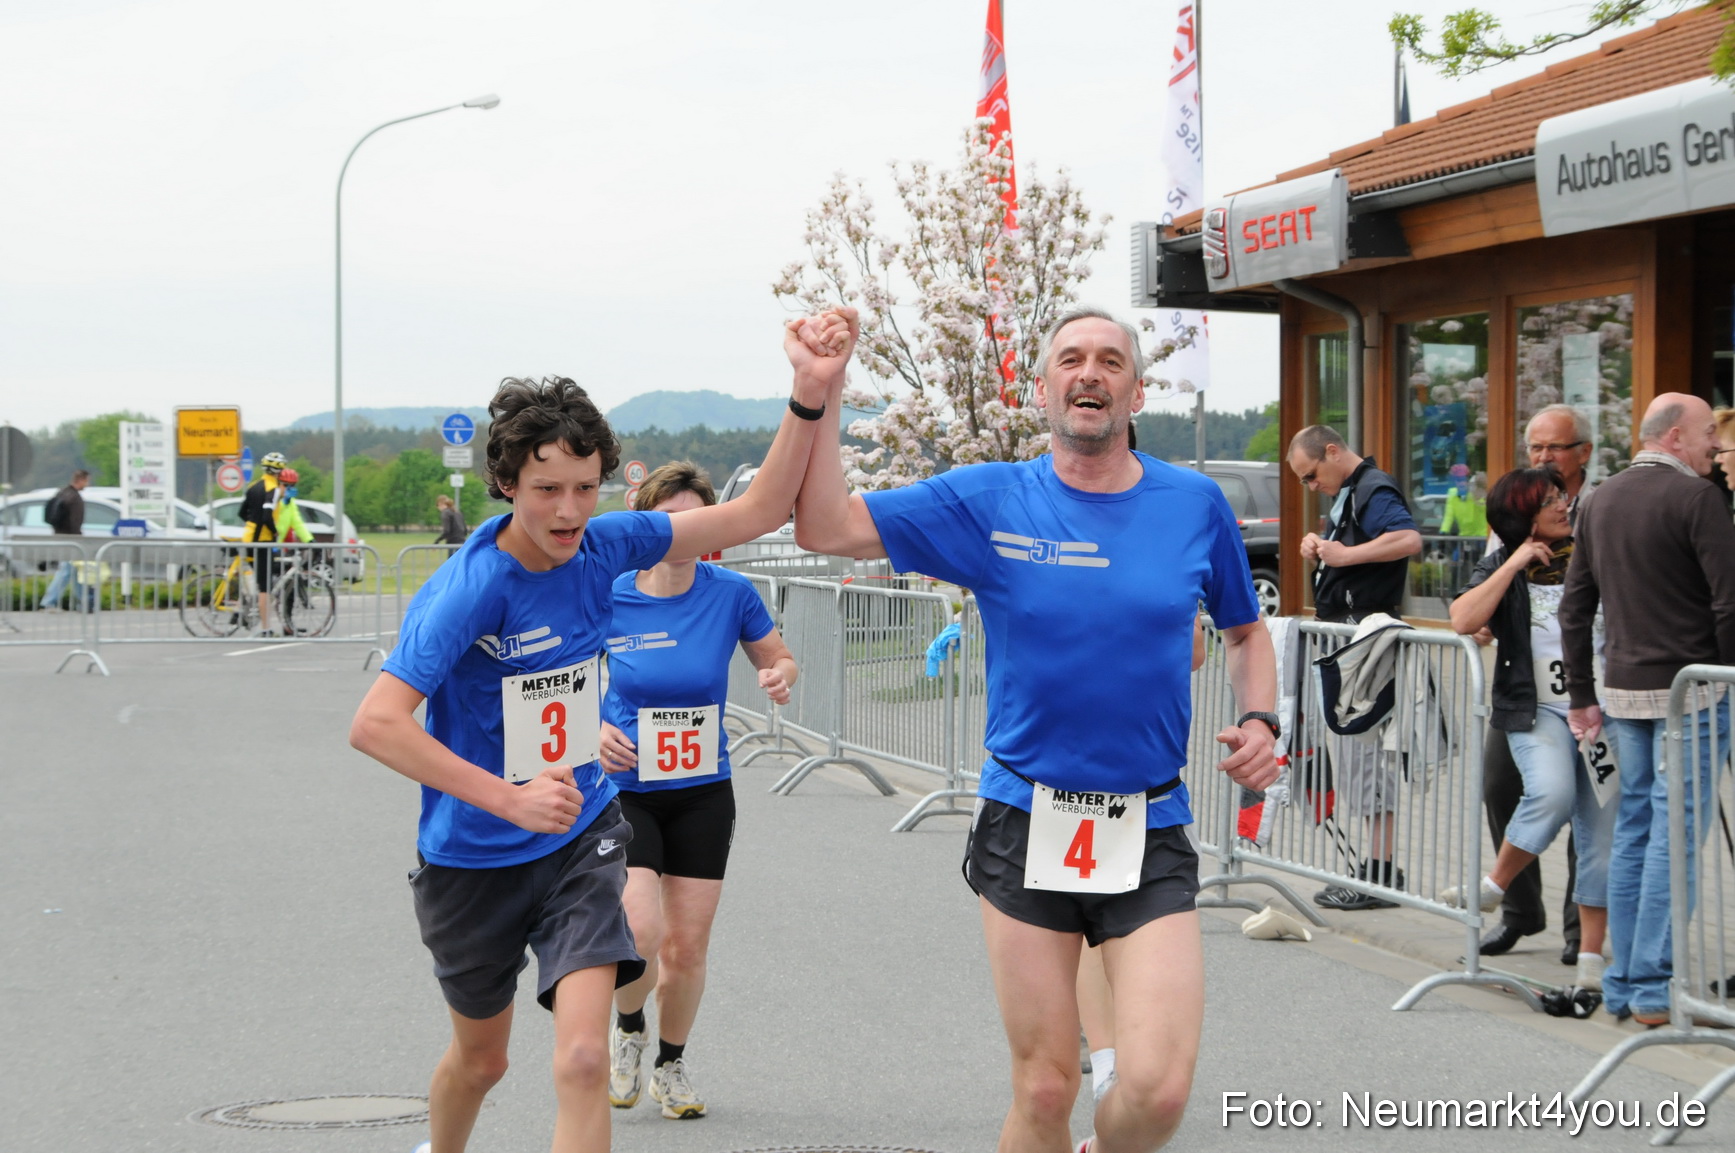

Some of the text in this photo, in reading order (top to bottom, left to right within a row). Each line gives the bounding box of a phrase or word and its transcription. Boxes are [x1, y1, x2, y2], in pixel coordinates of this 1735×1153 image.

[1557, 140, 1672, 195] Autohaus
[1242, 204, 1317, 254] SEAT
[183, 426, 233, 438] Neumarkt
[630, 468, 642, 480] 60
[521, 673, 570, 692] MEYER
[522, 685, 570, 701] WERBUNG
[652, 711, 689, 720] MEYER
[652, 719, 689, 727] WERBUNG
[541, 701, 567, 763] 3
[657, 730, 702, 772] 55
[1052, 790, 1105, 806] MEYER
[1052, 802, 1105, 816] WERBUNG
[600, 838, 616, 849] NIKE
[1063, 819, 1096, 879] 4
